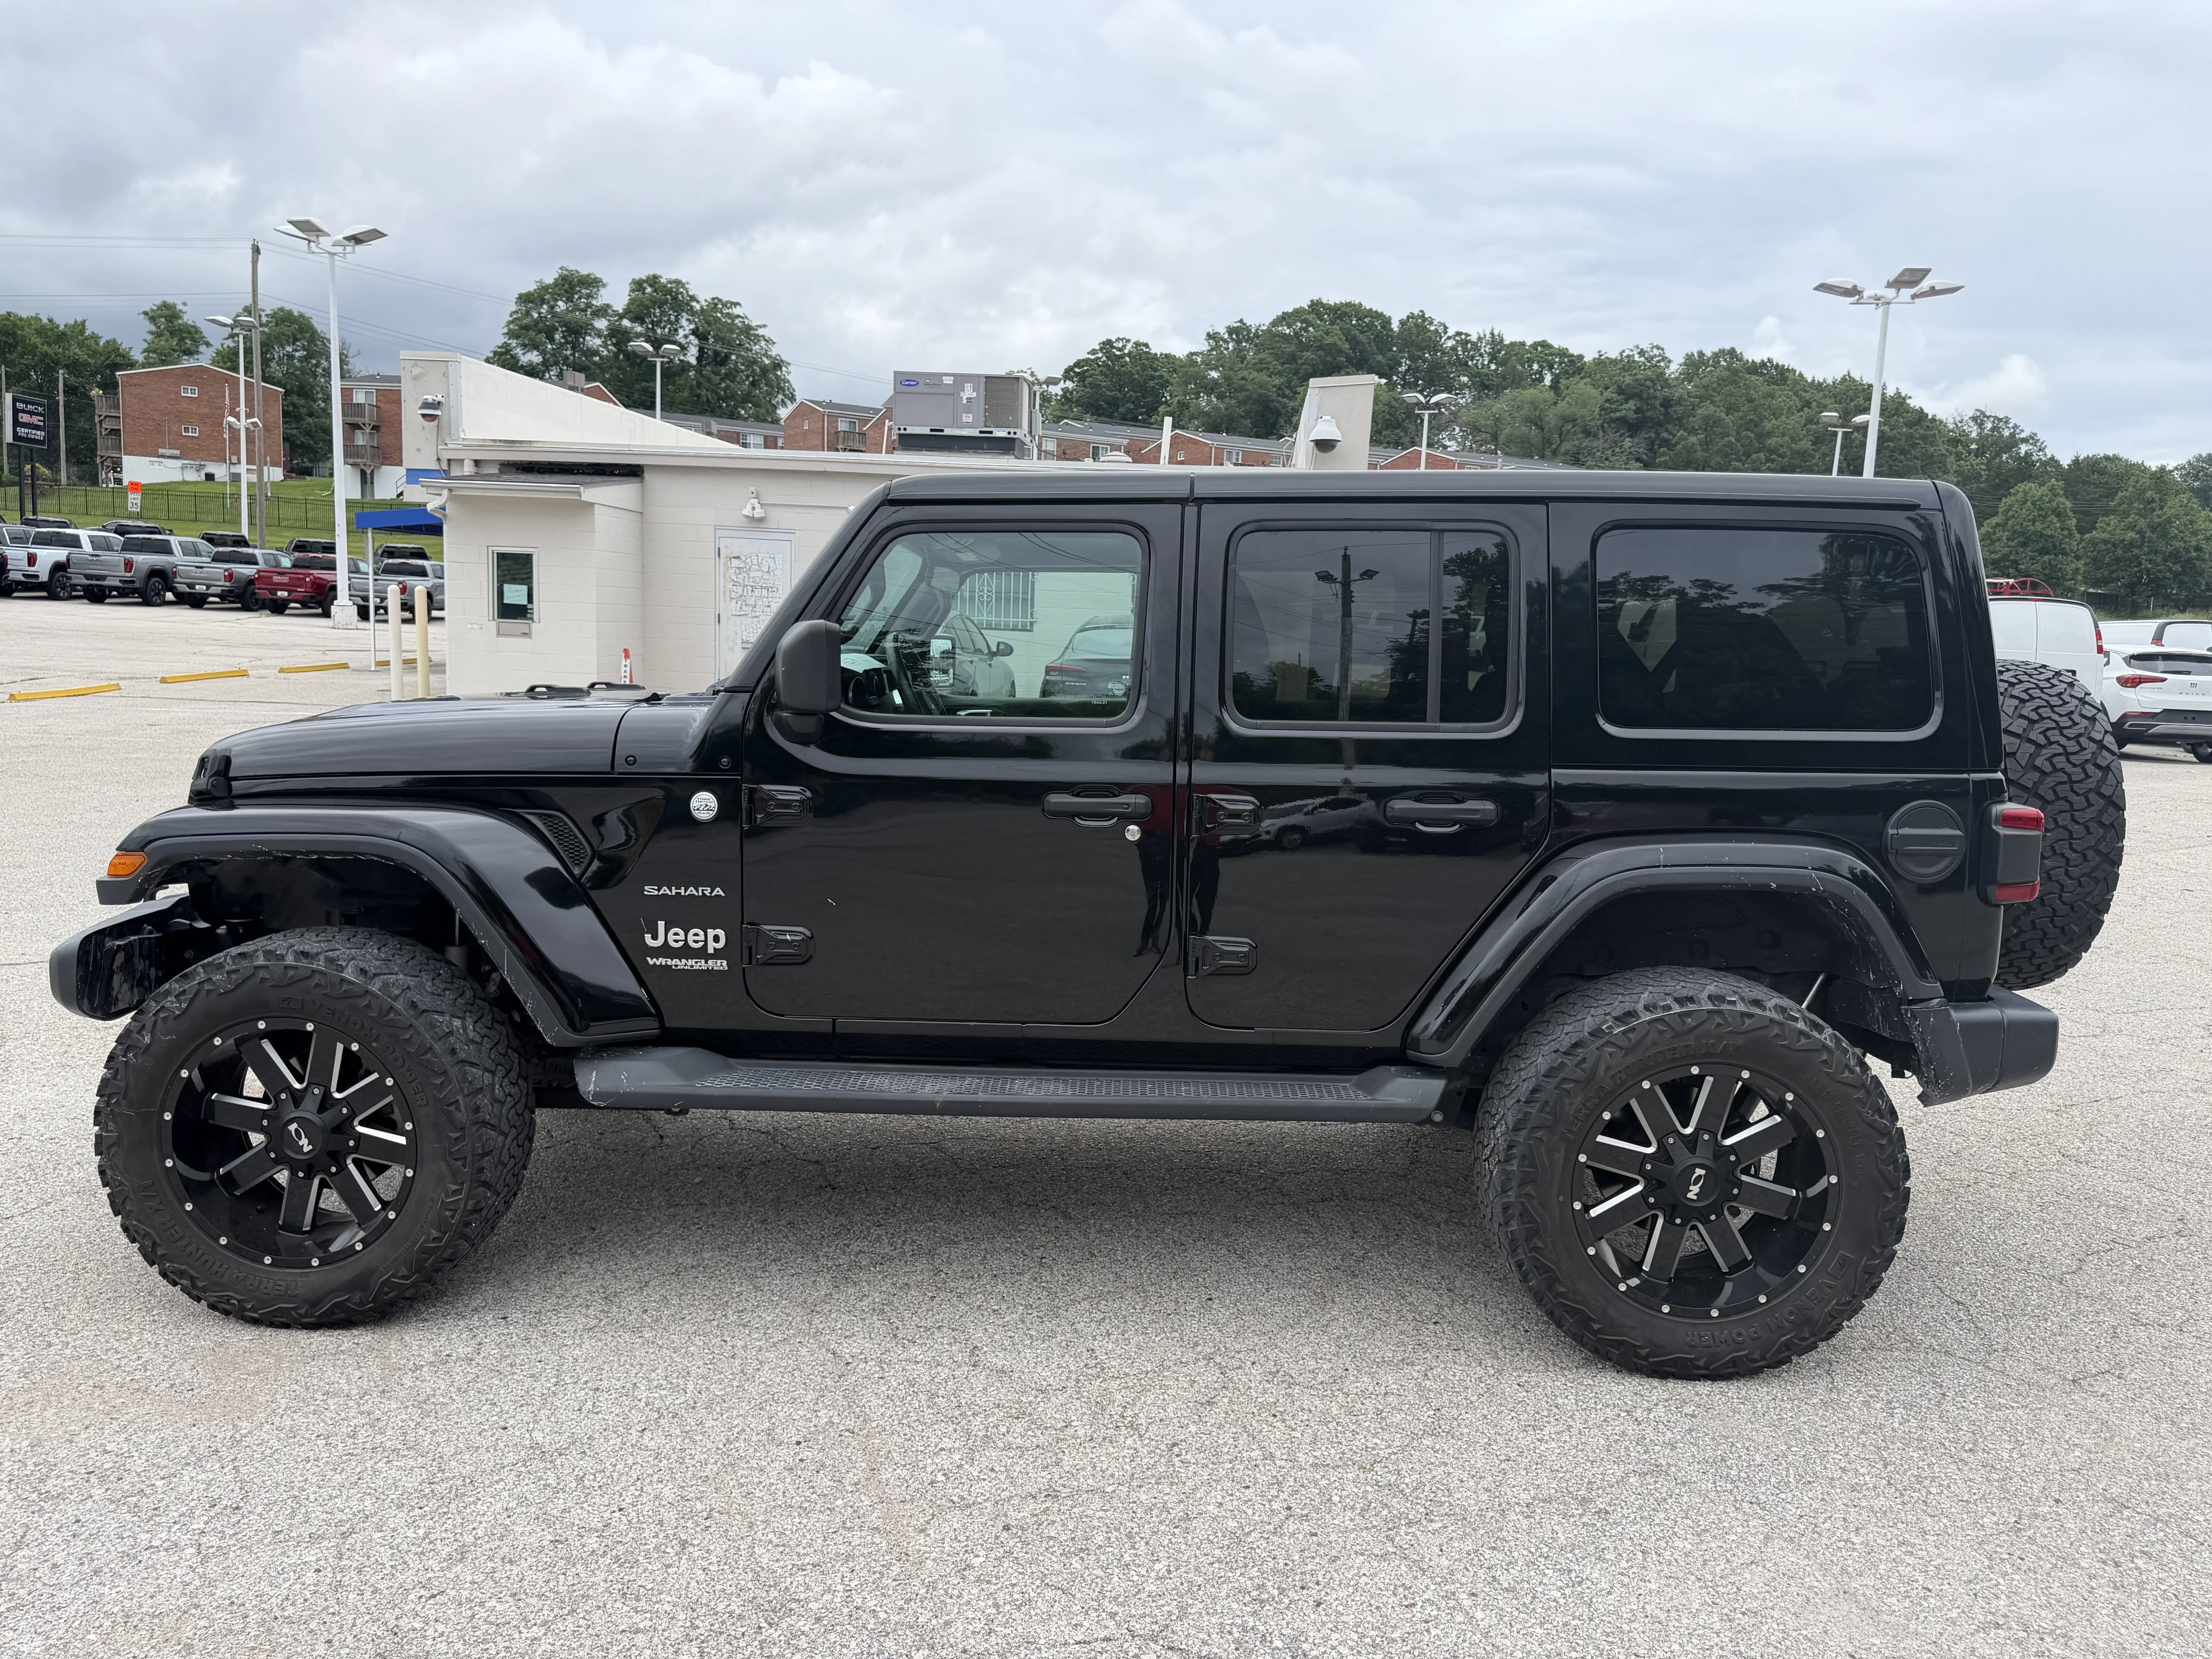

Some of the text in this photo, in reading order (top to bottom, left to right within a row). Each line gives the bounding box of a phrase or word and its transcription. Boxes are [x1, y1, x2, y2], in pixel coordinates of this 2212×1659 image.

[16, 402, 45, 413] BUICK
[19, 413, 43, 425] GMC
[17, 427, 45, 436] CERTIFIED
[644, 886, 725, 896] SAHARA
[644, 921, 726, 954] Jeep
[646, 957, 728, 967] WRANGLER
[311, 998, 428, 1108] VENOM POWER
[1561, 1040, 1741, 1142] TERRA HUNTER X/T
[288, 1122, 313, 1153] ION
[1686, 1168, 1706, 1200] ION
[138, 1180, 299, 1297] TERRA HUNTER X/T
[1686, 1279, 1837, 1348] VENOM POWER
